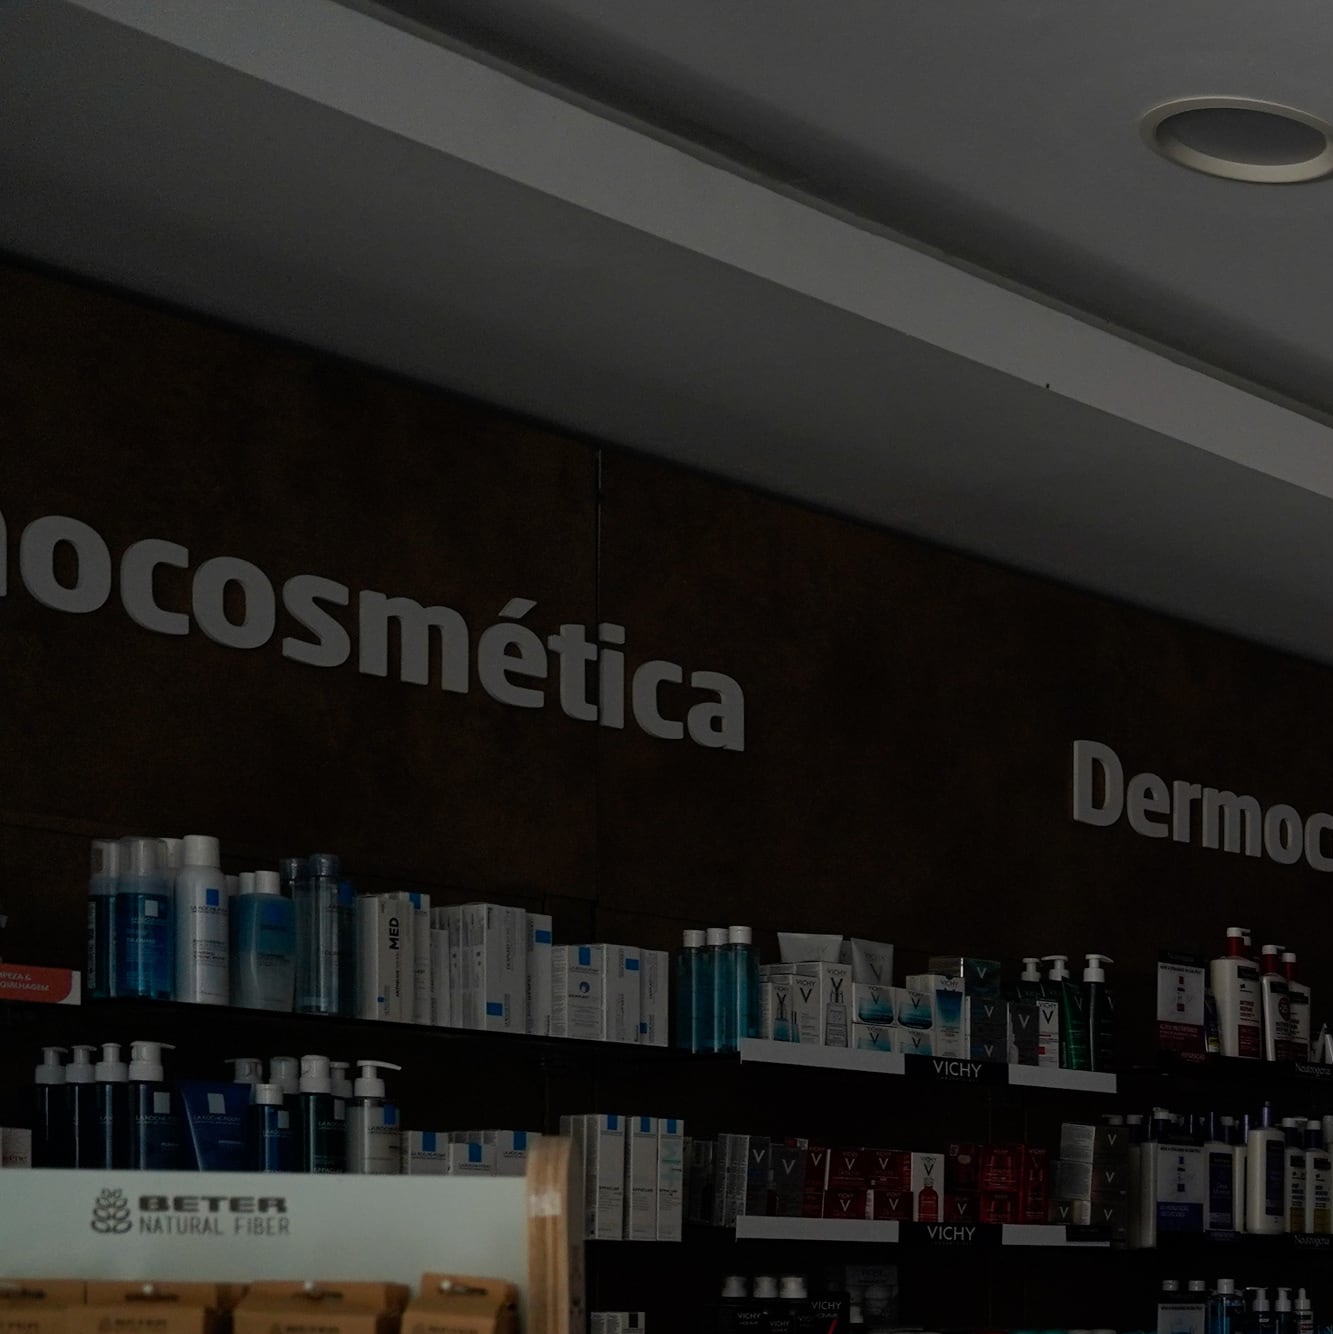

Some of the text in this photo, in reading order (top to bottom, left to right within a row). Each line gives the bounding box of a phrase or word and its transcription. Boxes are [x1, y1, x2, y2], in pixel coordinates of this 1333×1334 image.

[0, 514, 746, 752] ocosmética
[389, 917, 400, 950] MED
[933, 1058, 983, 1079] VICHY
[138, 1195, 288, 1214] BETER
[139, 1216, 290, 1236] NATURAL FIBER
[927, 1225, 977, 1241] VICHY
[811, 1300, 843, 1311] VICHY
